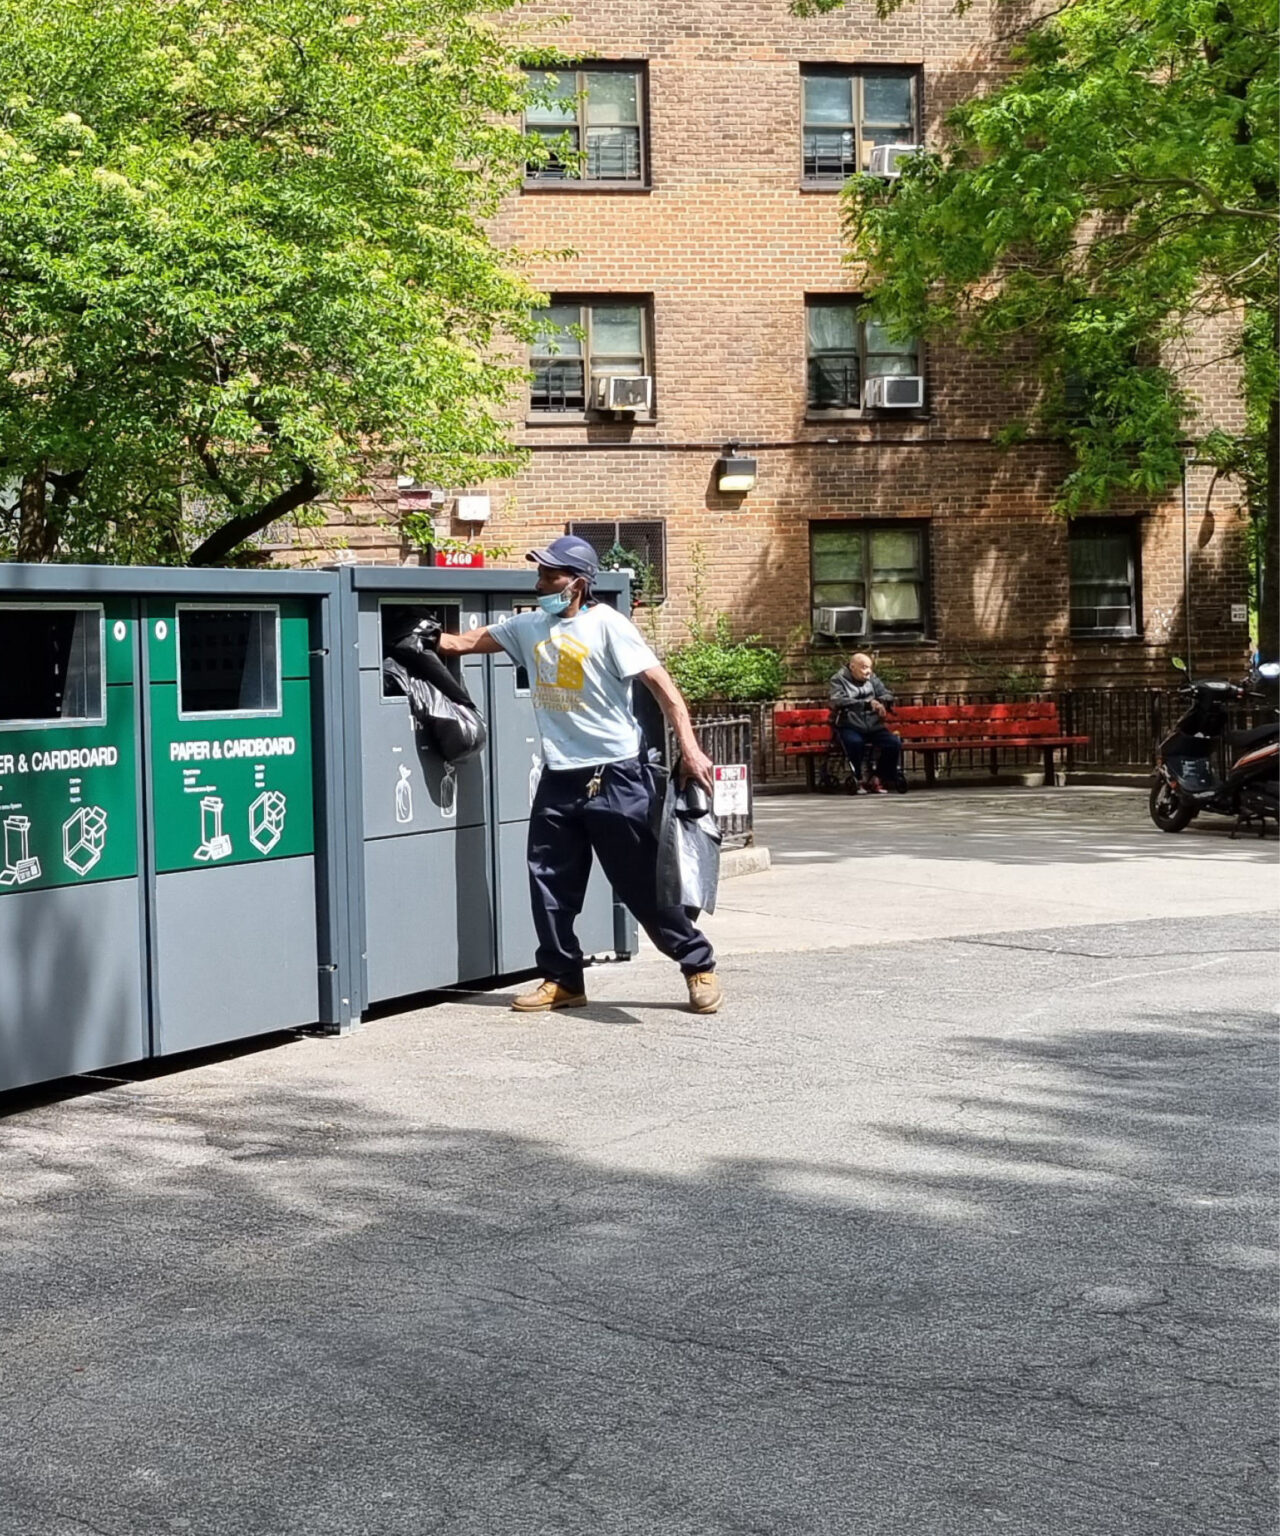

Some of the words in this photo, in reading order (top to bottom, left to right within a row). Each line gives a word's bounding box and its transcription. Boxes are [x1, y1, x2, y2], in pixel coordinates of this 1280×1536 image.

[17, 753, 29, 773] &
[31, 746, 118, 771] CARDBOARD
[170, 741, 210, 761] PAPER
[212, 740, 222, 759] &
[223, 737, 295, 759] CARDBOARD
